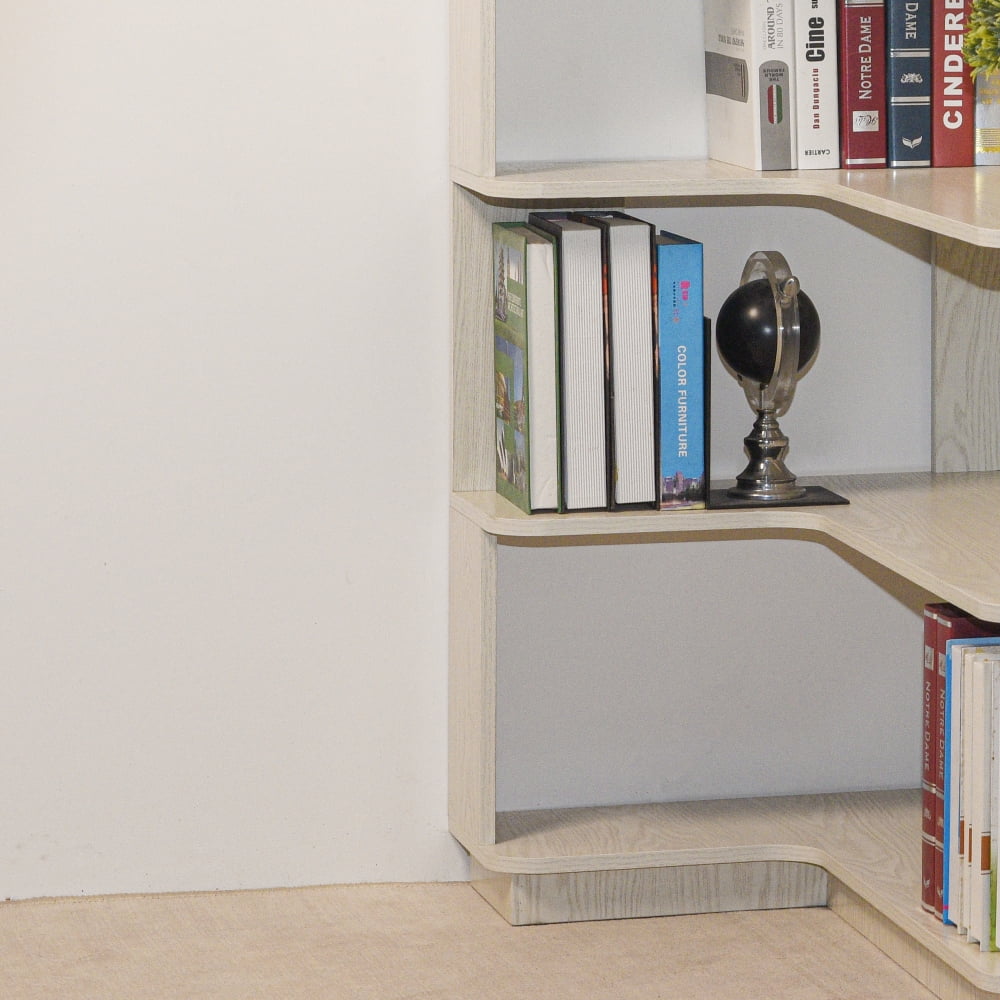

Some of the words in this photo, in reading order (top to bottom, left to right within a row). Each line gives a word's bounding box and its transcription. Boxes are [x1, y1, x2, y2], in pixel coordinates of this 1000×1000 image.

[766, 6, 776, 50] AROUND
[775, 3, 784, 25] DAYS
[858, 16, 873, 53] DAME
[905, 2, 919, 40] DAME
[776, 38, 785, 49] IN
[805, 16, 826, 62] Cine
[812, 68, 821, 110] Dungaciu
[858, 56, 872, 100] NOTRE
[812, 113, 820, 129] Dan
[677, 345, 687, 386] COLOR
[678, 390, 688, 457] FURNITURE
